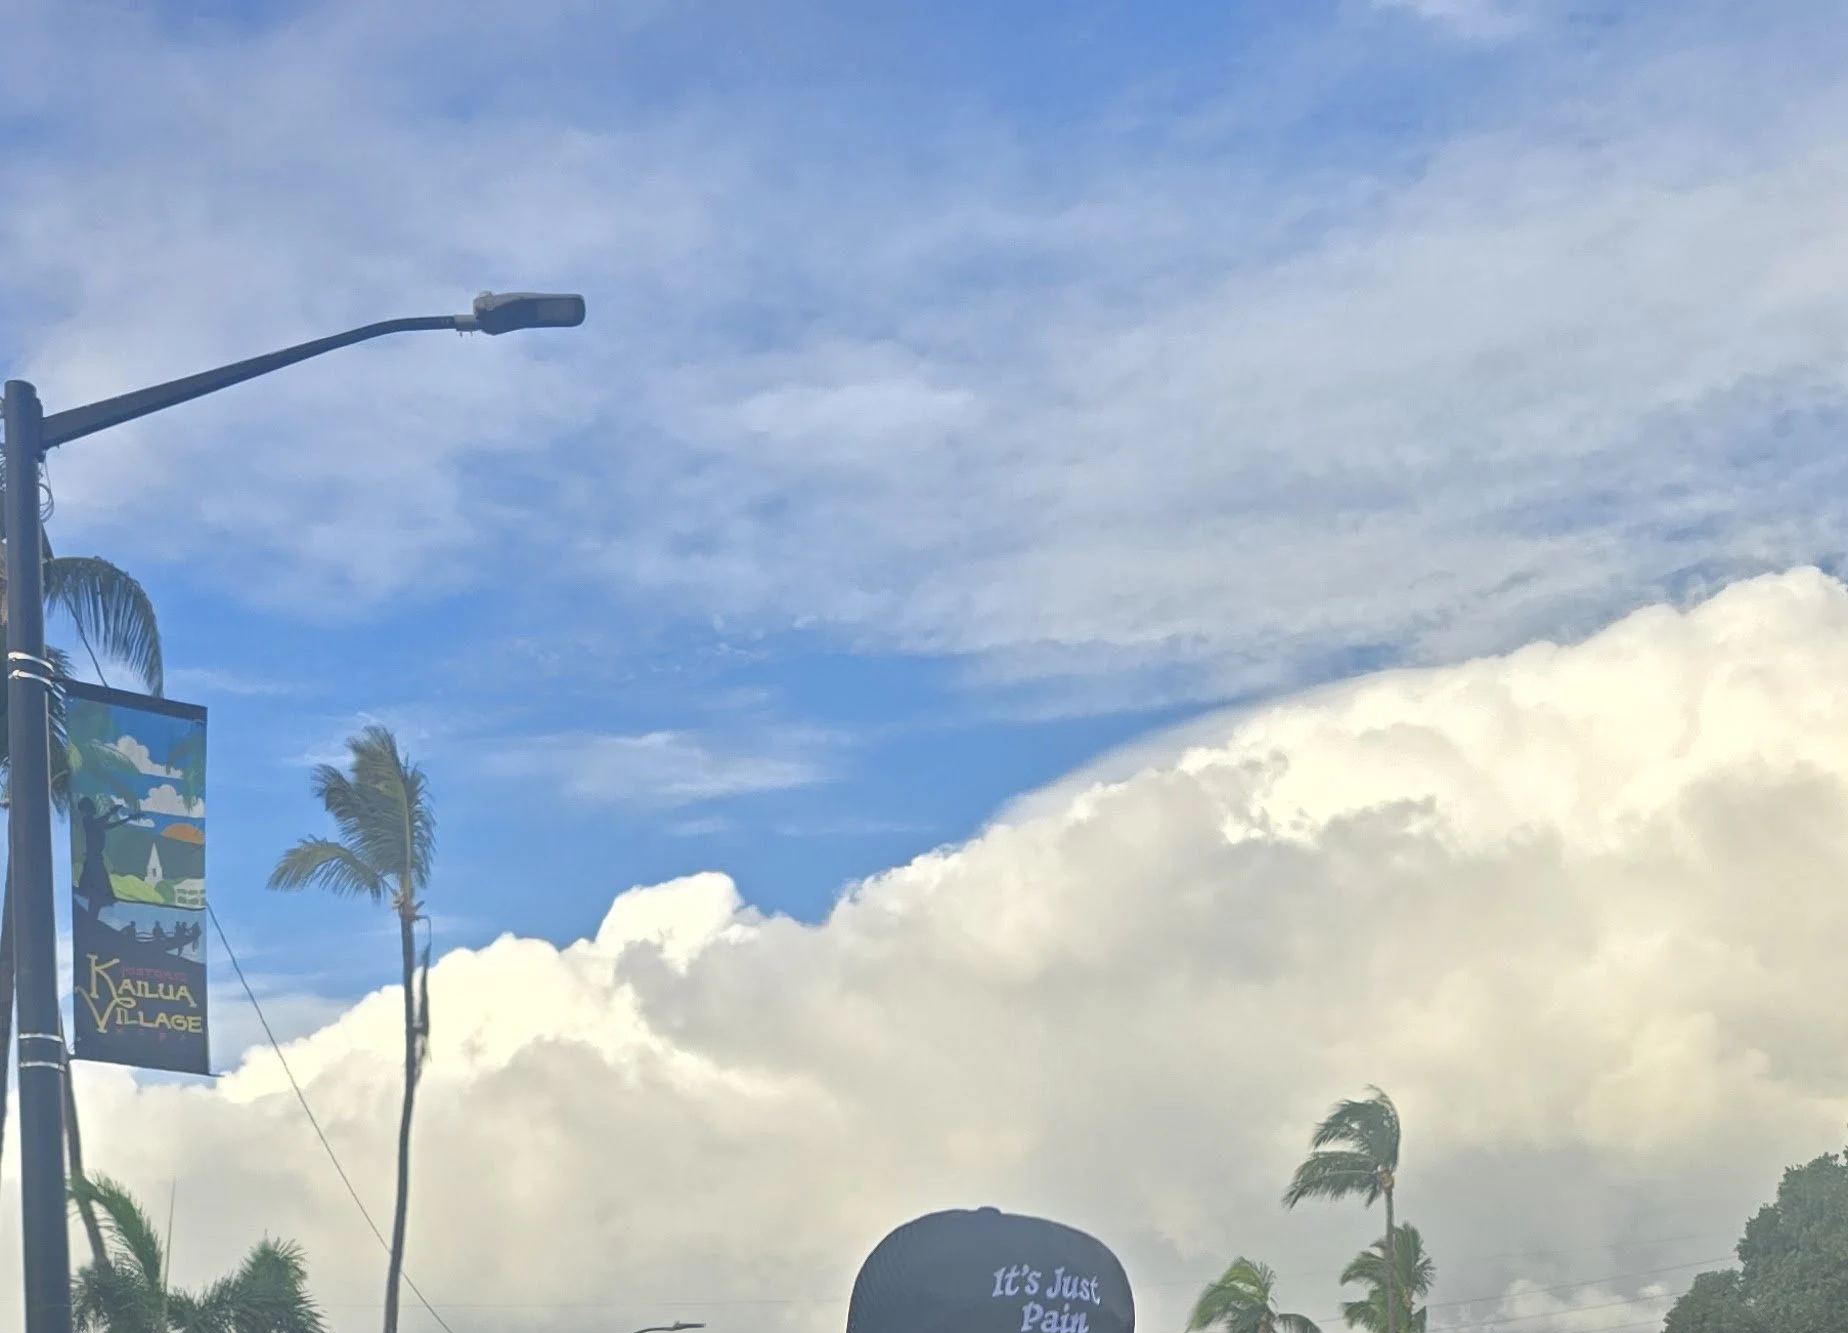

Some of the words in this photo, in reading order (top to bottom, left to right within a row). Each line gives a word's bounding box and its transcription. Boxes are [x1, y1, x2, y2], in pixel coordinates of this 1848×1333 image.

[86, 952, 198, 1009] KAILUA
[75, 985, 203, 1034] VILLAGE
[992, 1264, 1042, 1298] It's
[1046, 1266, 1102, 1306] Just
